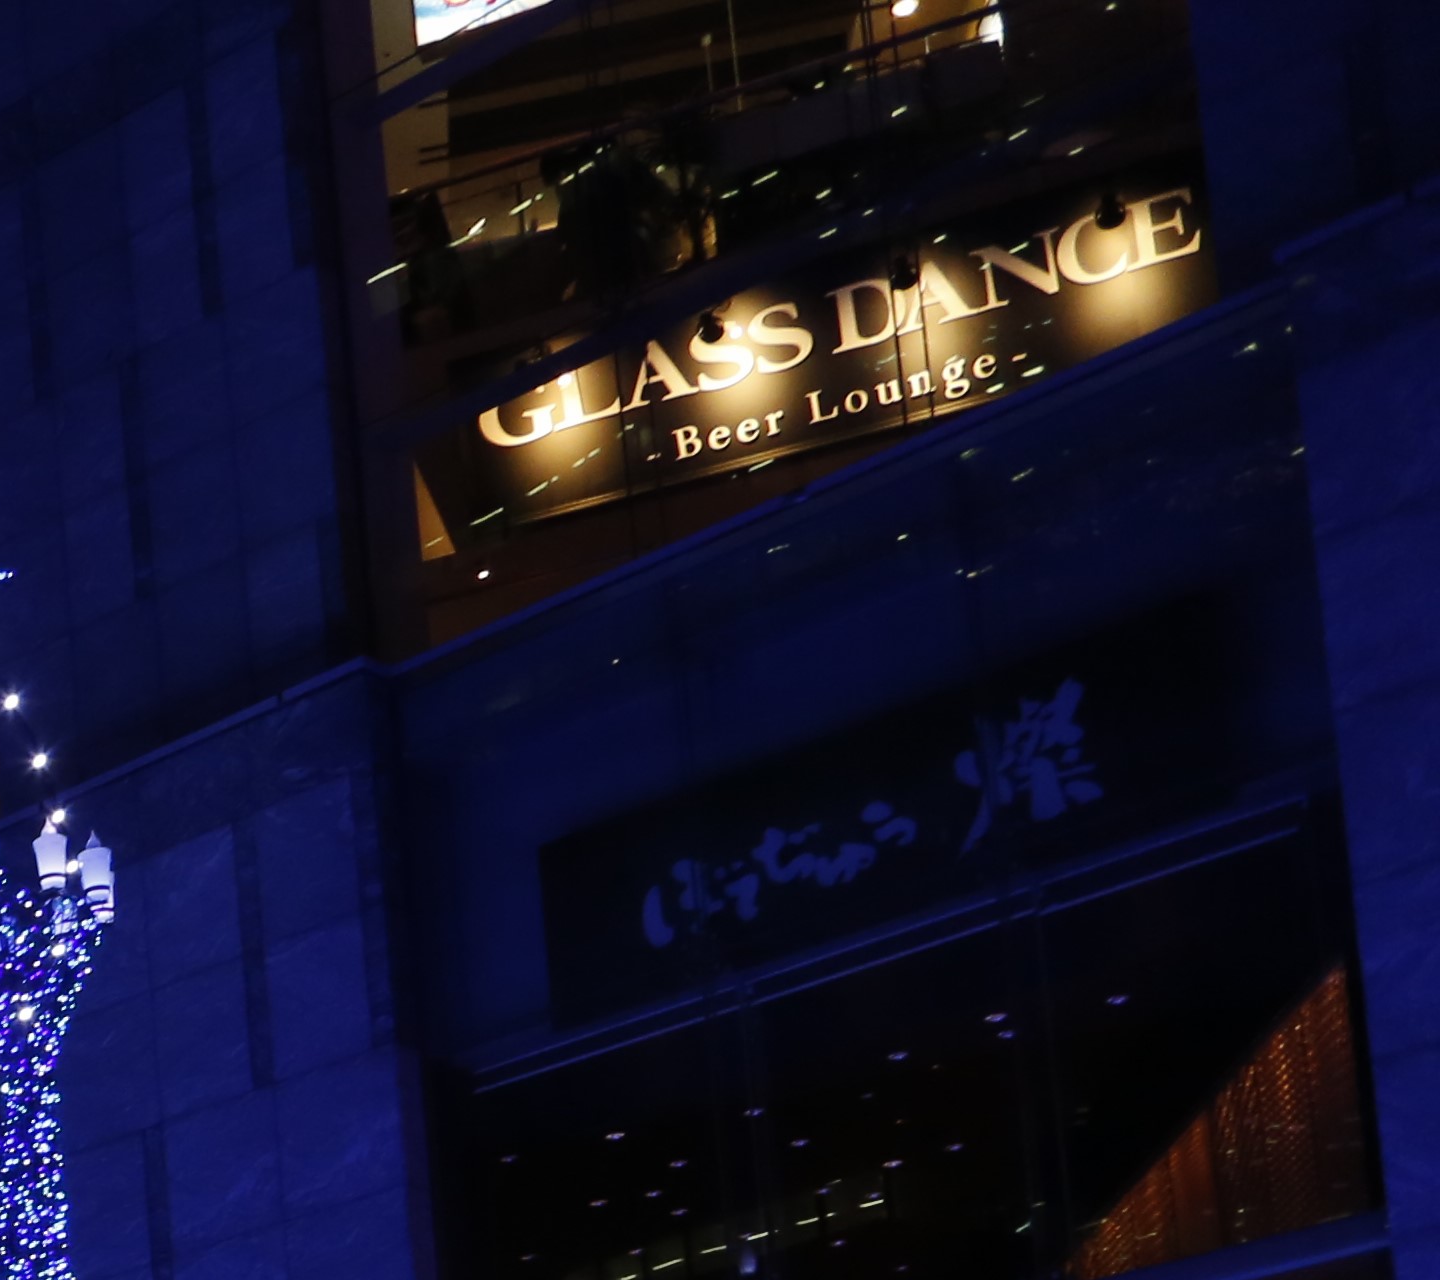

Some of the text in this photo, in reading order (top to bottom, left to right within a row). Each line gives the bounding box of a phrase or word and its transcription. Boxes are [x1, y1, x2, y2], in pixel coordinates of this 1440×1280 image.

[478, 186, 1203, 448] GLASS DANCE
[672, 351, 999, 463] Beer Lounge
